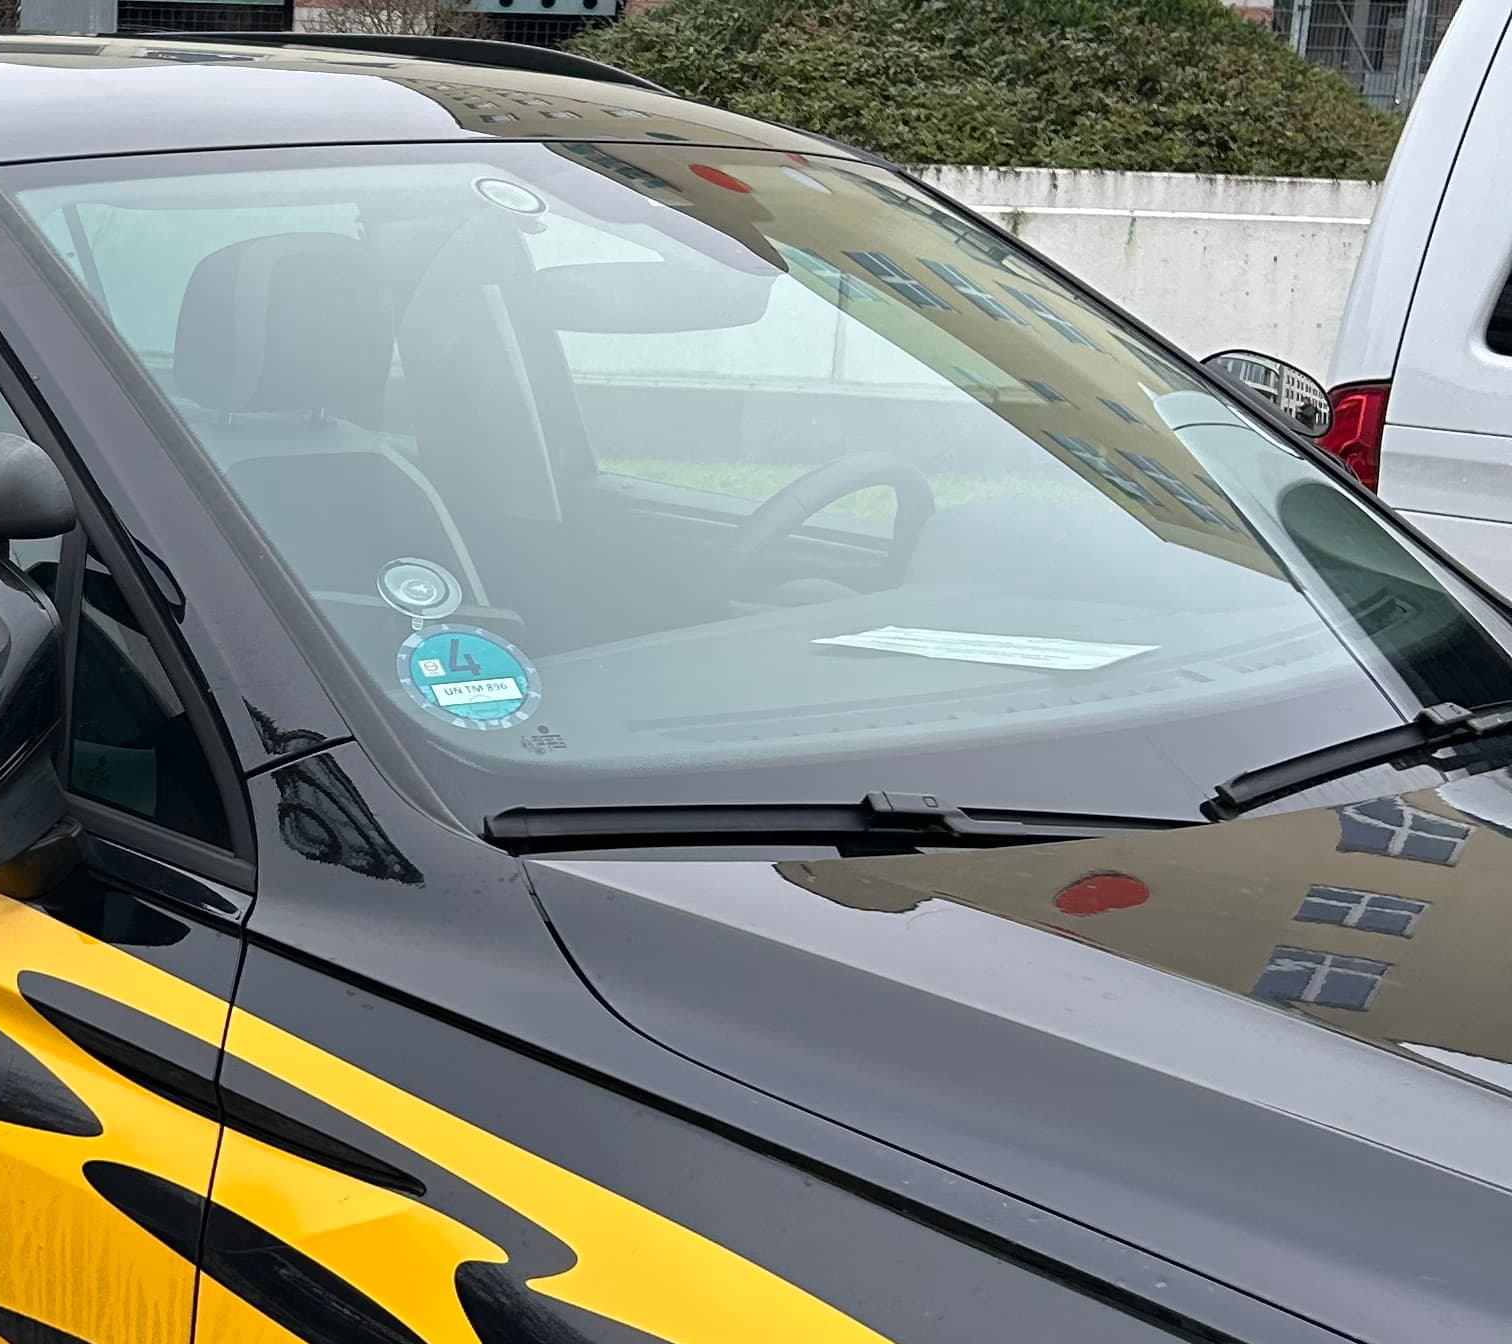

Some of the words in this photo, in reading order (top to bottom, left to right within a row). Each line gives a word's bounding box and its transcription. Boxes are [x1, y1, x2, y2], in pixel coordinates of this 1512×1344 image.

[447, 638, 482, 676] 4
[443, 686, 463, 696] UN
[464, 684, 484, 694] TM
